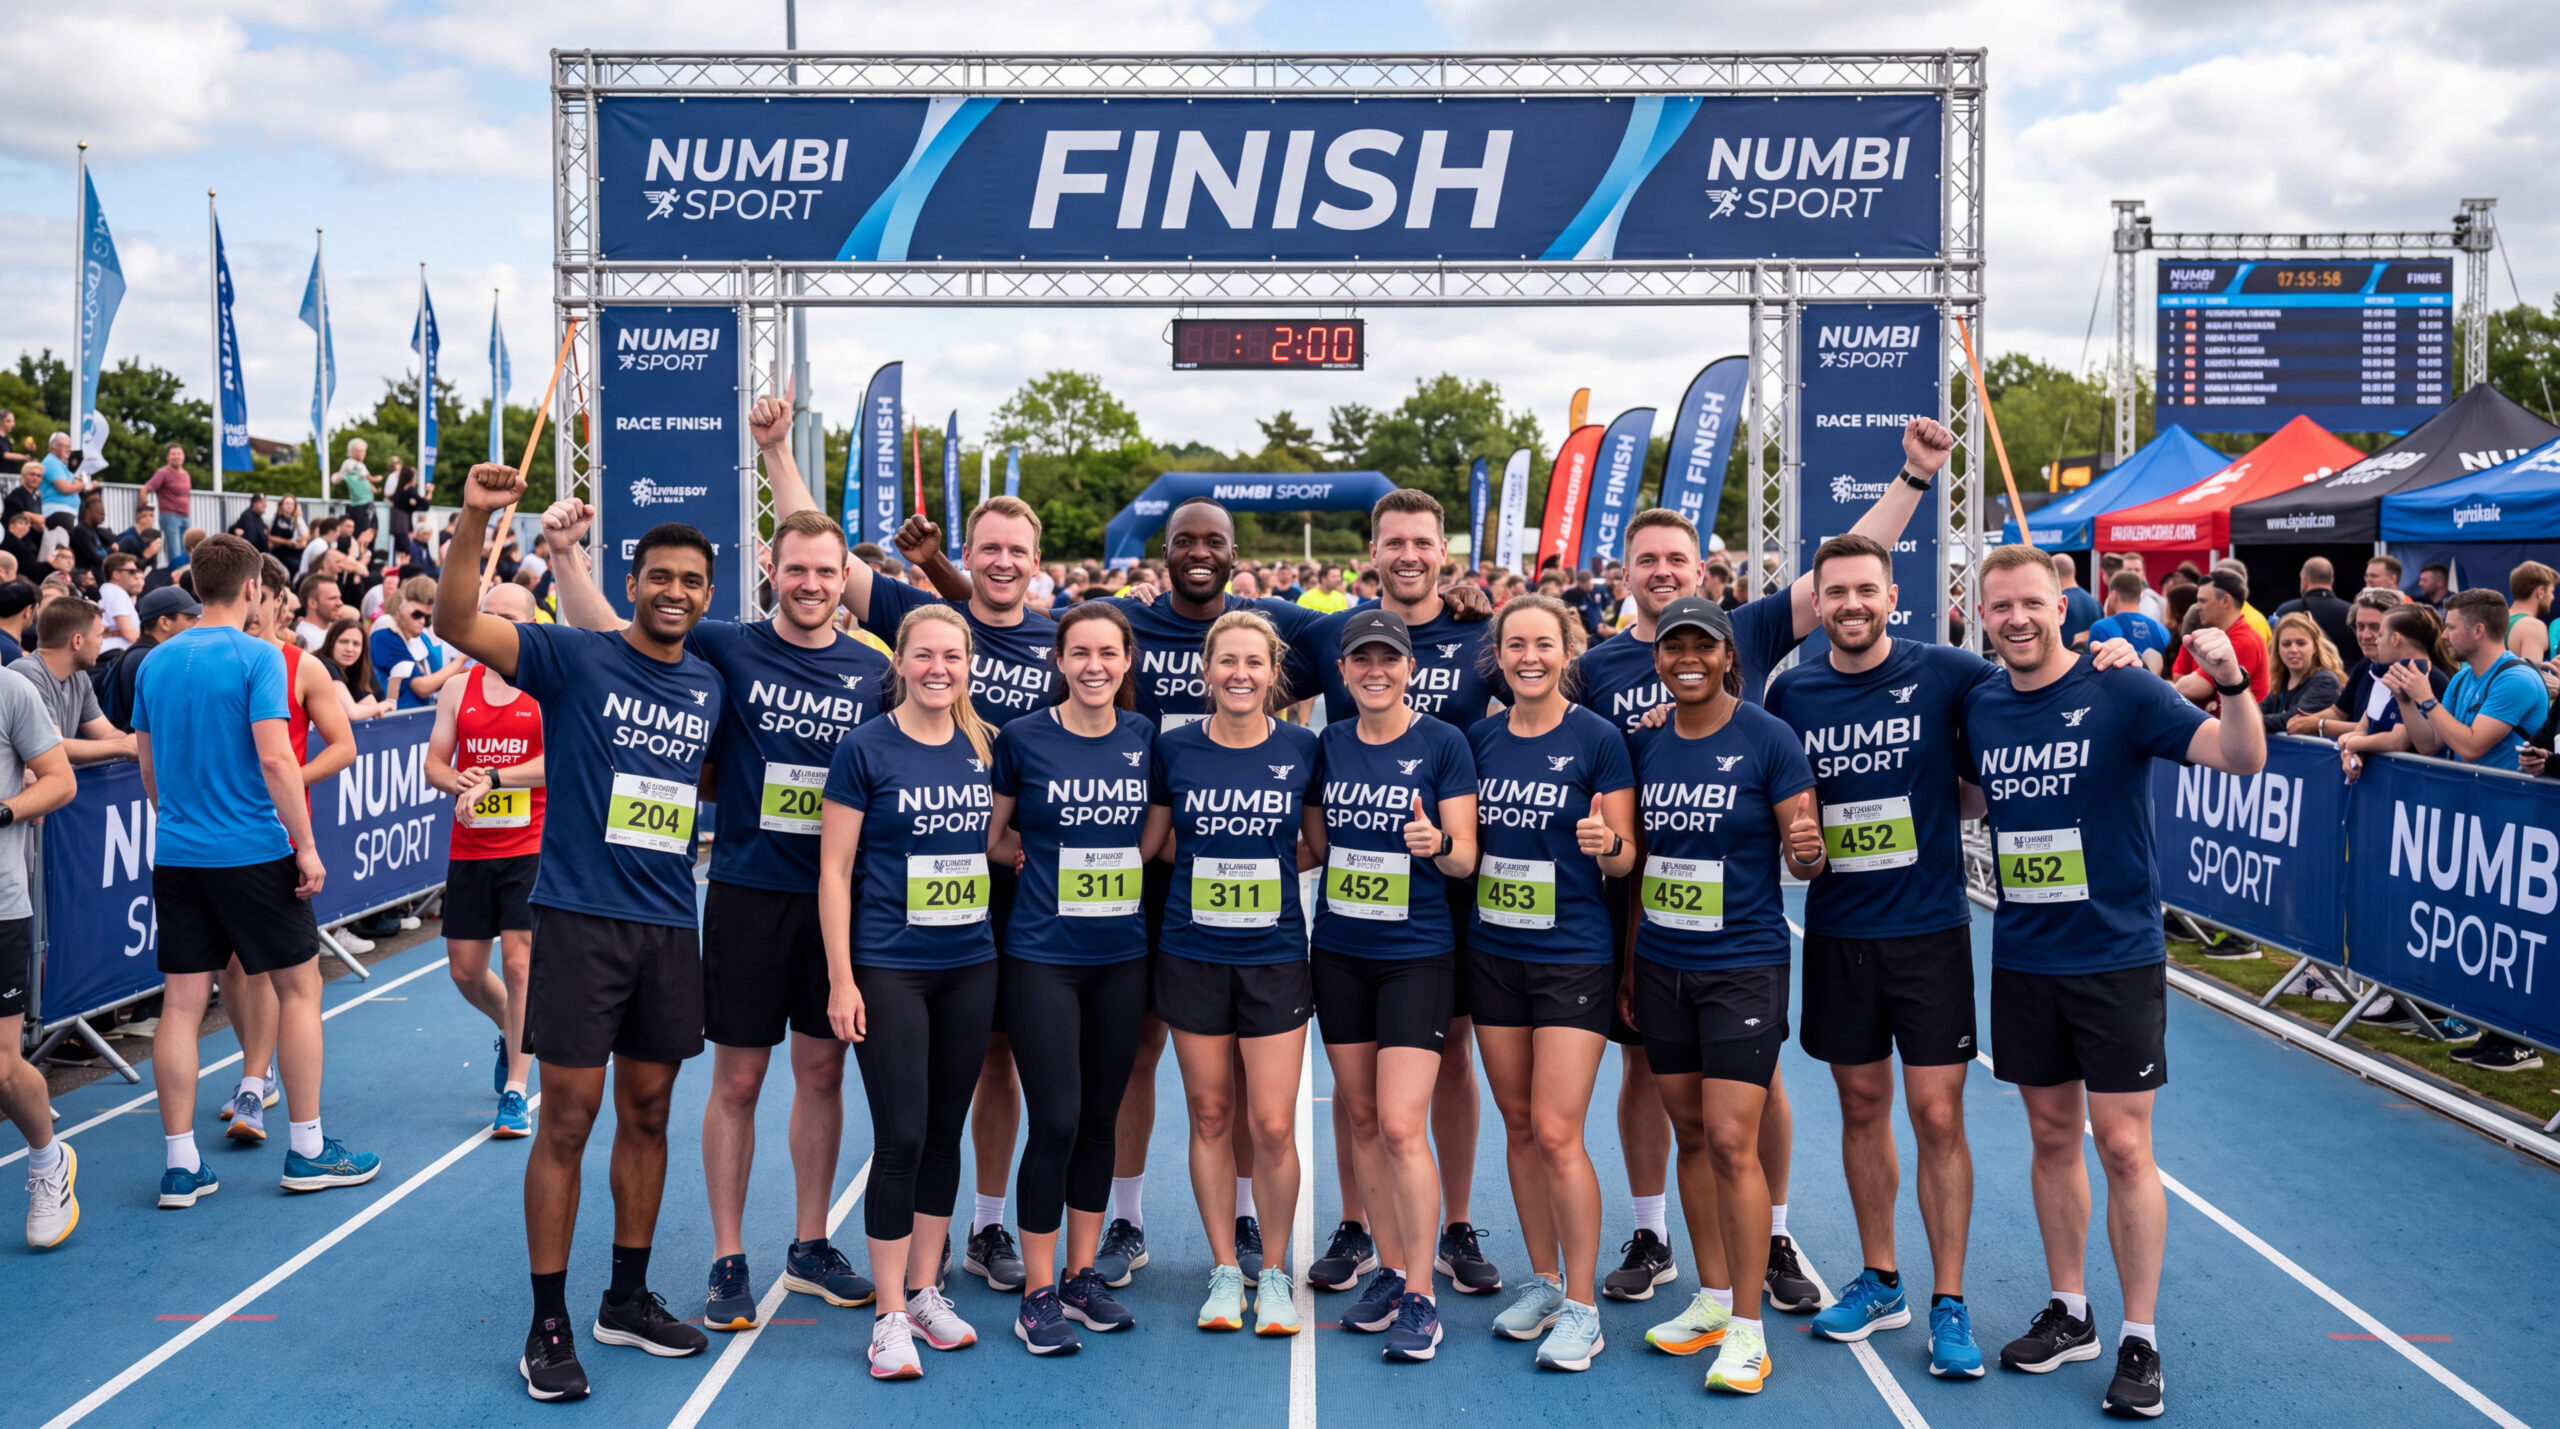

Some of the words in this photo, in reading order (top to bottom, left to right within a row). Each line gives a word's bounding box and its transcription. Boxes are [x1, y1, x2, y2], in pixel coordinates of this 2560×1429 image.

[645, 138, 849, 182] NUMBI
[1707, 136, 1911, 181] NUMBI
[1028, 128, 1514, 231] FINISH
[682, 189, 823, 220] SPORT
[1744, 187, 1884, 219] SPORT
[2170, 269, 2216, 281] NUMBI
[617, 327, 720, 351] NUMBI
[1271, 326, 1354, 361] 2:00
[1818, 325, 1921, 349] NUMBI
[636, 353, 709, 371] SPORT
[1836, 351, 1909, 369] SPORT
[616, 416, 662, 431] RACE
[666, 416, 722, 431] FINISH
[1816, 413, 1862, 428] RACE
[877, 396, 895, 479] FINISH
[1685, 390, 1727, 485] FINISH
[1605, 433, 1636, 508] FINISH
[1212, 484, 1274, 500] NUMBI
[1275, 483, 1334, 500] SPORT
[1596, 511, 1620, 568] ACE
[970, 653, 1052, 693] UMBI
[1407, 667, 1461, 691] MBI
[748, 679, 863, 725] NUMBI
[968, 680, 1040, 711] PORT
[602, 692, 710, 743] NUMBI
[758, 711, 851, 744] SPORT
[466, 738, 528, 754] NUMBI
[612, 726, 701, 763] SPORT
[1804, 714, 1921, 756] NUMBI
[475, 754, 521, 764] SPORT
[1817, 747, 1910, 779] SPORT
[1981, 739, 2091, 776] NUMBI
[898, 783, 994, 813] NUMBI
[1047, 778, 1148, 803] NUMBI
[1184, 788, 1293, 815] NUMBI
[1322, 781, 1420, 811] NUMBI
[1478, 778, 1569, 809] NUMBI
[1640, 782, 1738, 810] NUMBI
[1990, 772, 2077, 801] SPORT
[779, 788, 823, 816] 20
[1060, 805, 1143, 827] SPORT
[2175, 763, 2304, 848] NUMBI
[628, 801, 680, 834] 204
[911, 811, 991, 836] SPORT
[1195, 816, 1283, 837] SPORT
[1326, 808, 1406, 832] SPORT
[1478, 805, 1555, 831] SPORT
[1644, 811, 1723, 833] SPORT
[352, 813, 436, 881] SPORT
[1839, 824, 1897, 854] 452
[2012, 855, 2065, 884] 452
[2188, 835, 2282, 907] SPORT
[926, 879, 977, 906] 204
[1076, 873, 1124, 898] 311
[1209, 882, 1260, 908] 311
[1339, 873, 1389, 902] 452
[1487, 882, 1536, 910] 453
[1653, 881, 1703, 911] 452
[2406, 900, 2548, 995] SPORT
